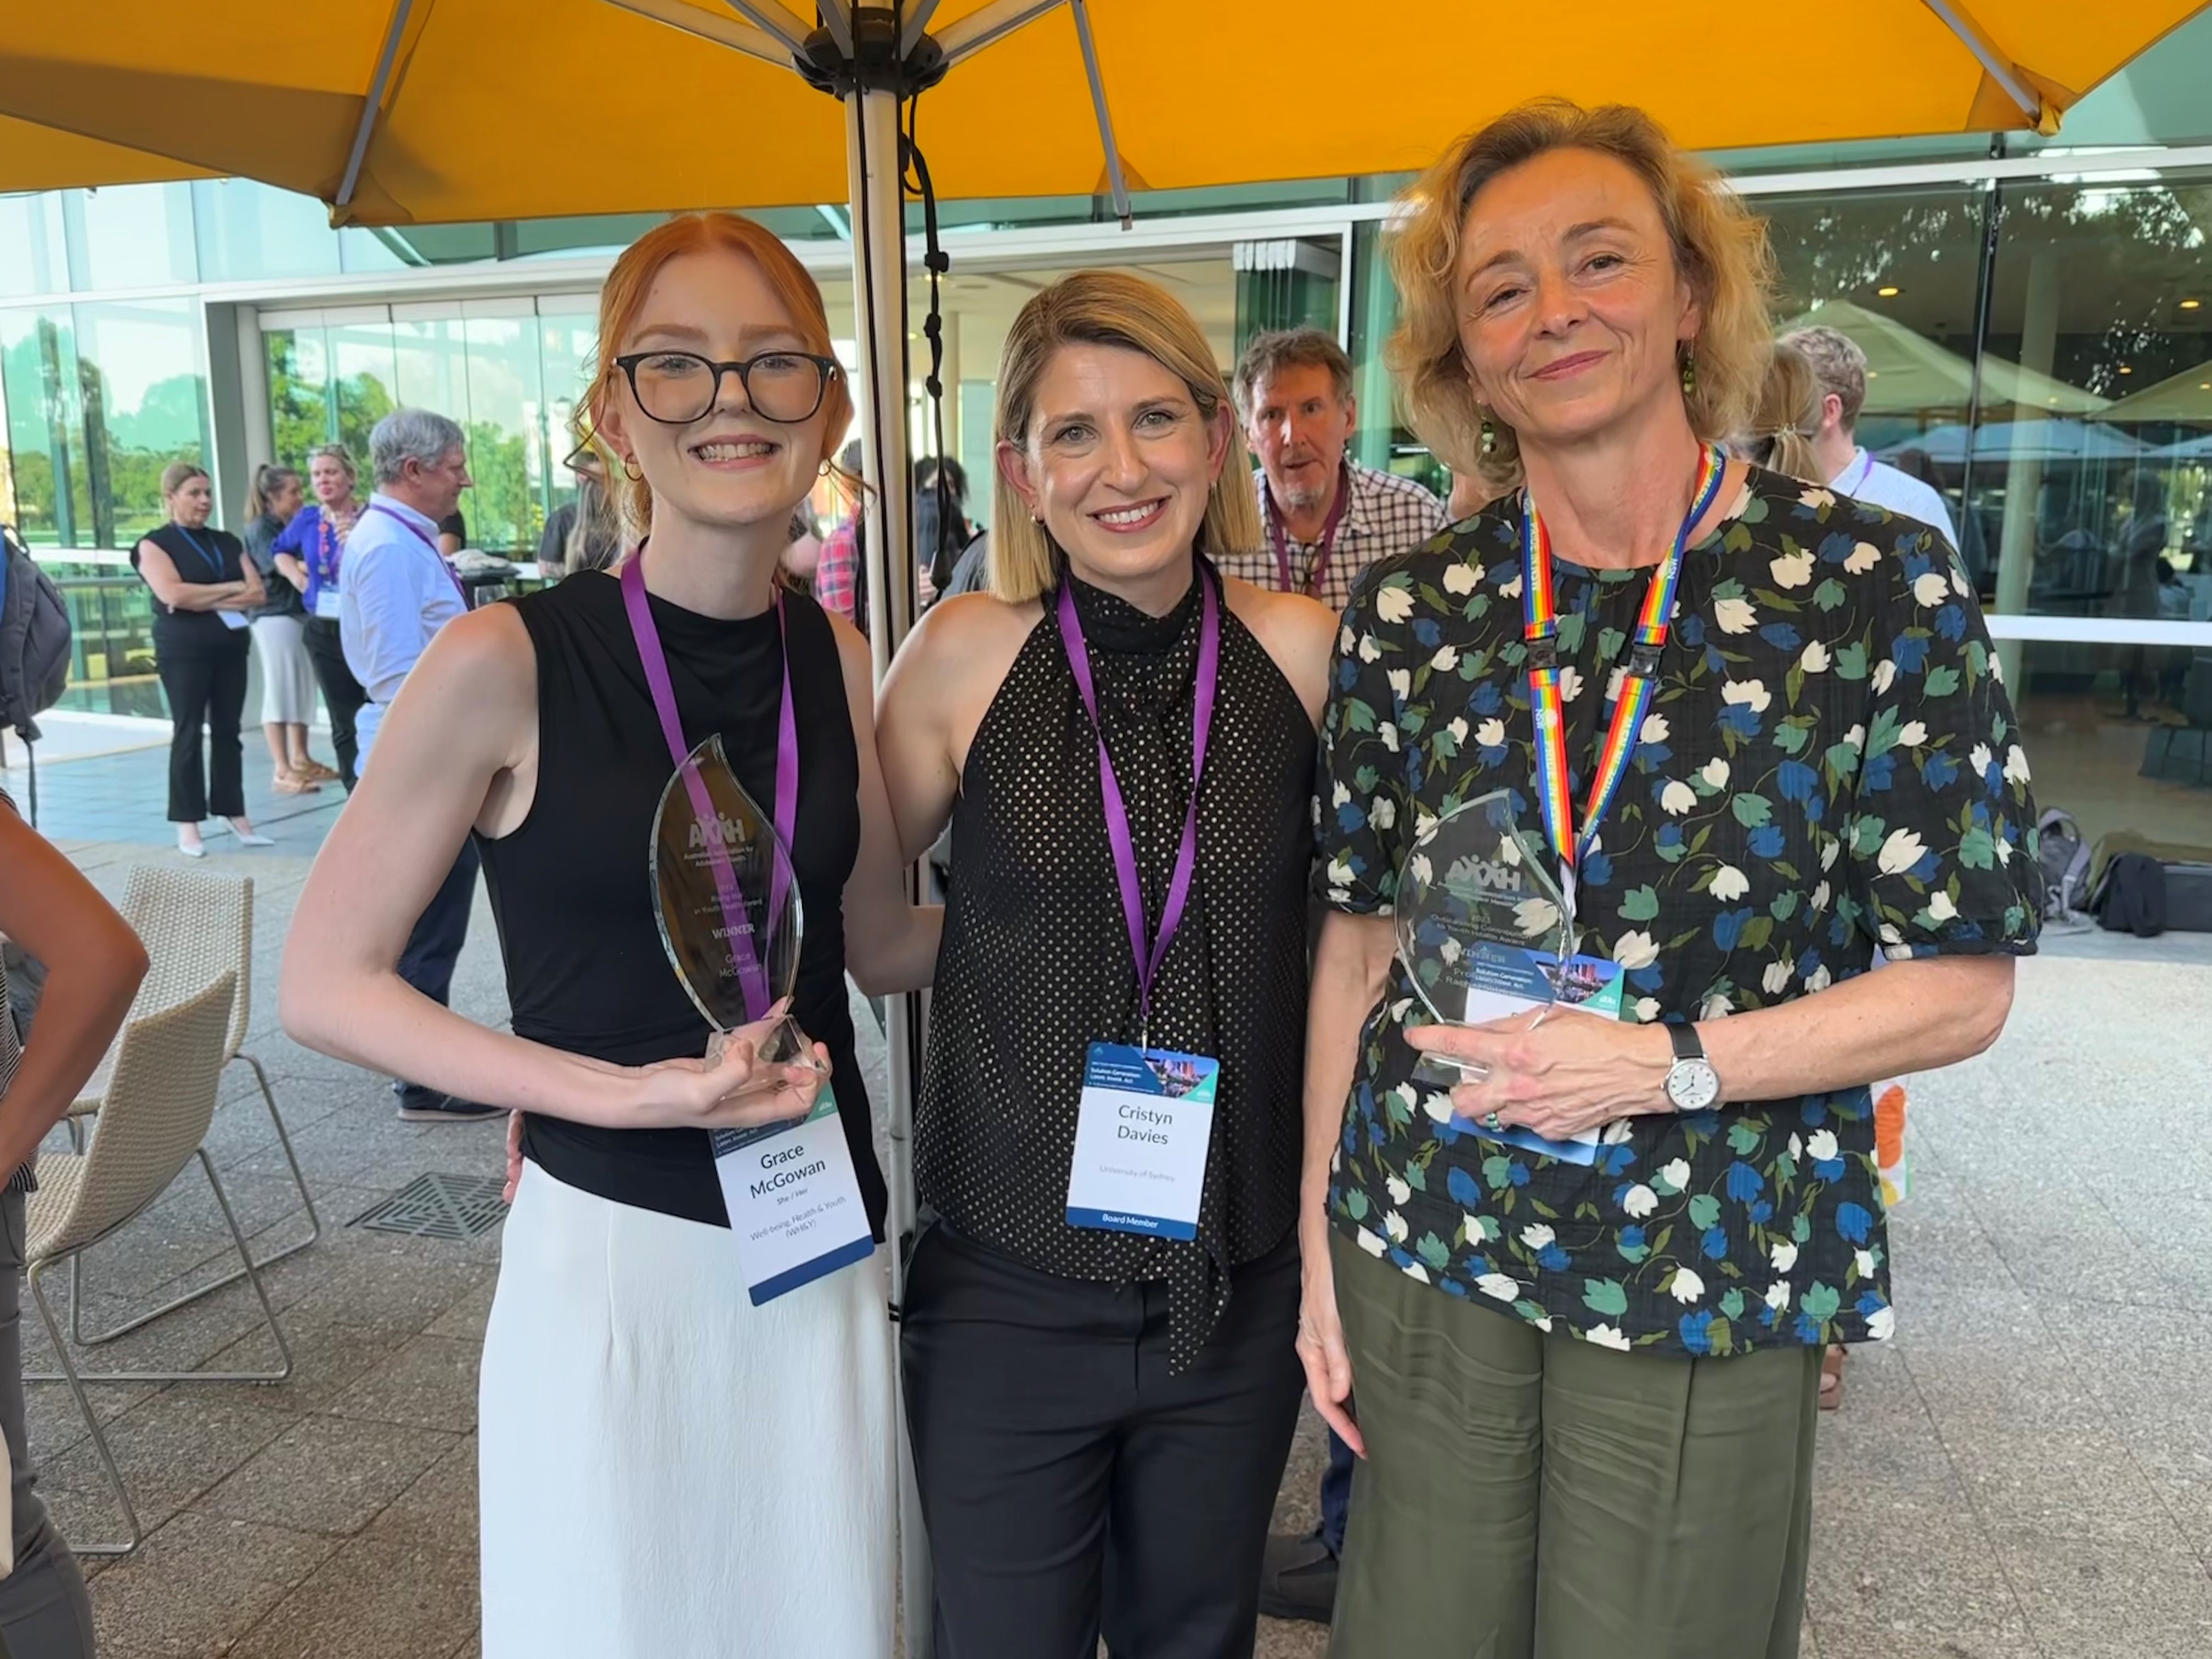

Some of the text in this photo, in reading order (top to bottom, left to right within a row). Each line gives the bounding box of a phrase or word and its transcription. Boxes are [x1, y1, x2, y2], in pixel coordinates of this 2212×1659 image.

[1535, 708, 1544, 729] NSW
[712, 923, 755, 939] WINNER
[725, 952, 751, 963] Grace
[1118, 1104, 1173, 1126] Cristyn
[1118, 1125, 1169, 1144] Davies
[760, 1144, 805, 1169] Grace
[750, 1160, 826, 1198] McGowan
[1099, 1164, 1174, 1183] University of Sydney
[777, 1195, 789, 1205] She
[794, 1188, 808, 1197] Her
[792, 1207, 817, 1223] Health
[817, 1204, 824, 1212] &
[824, 1195, 846, 1210] Youth
[1102, 1213, 1159, 1228] Board Member
